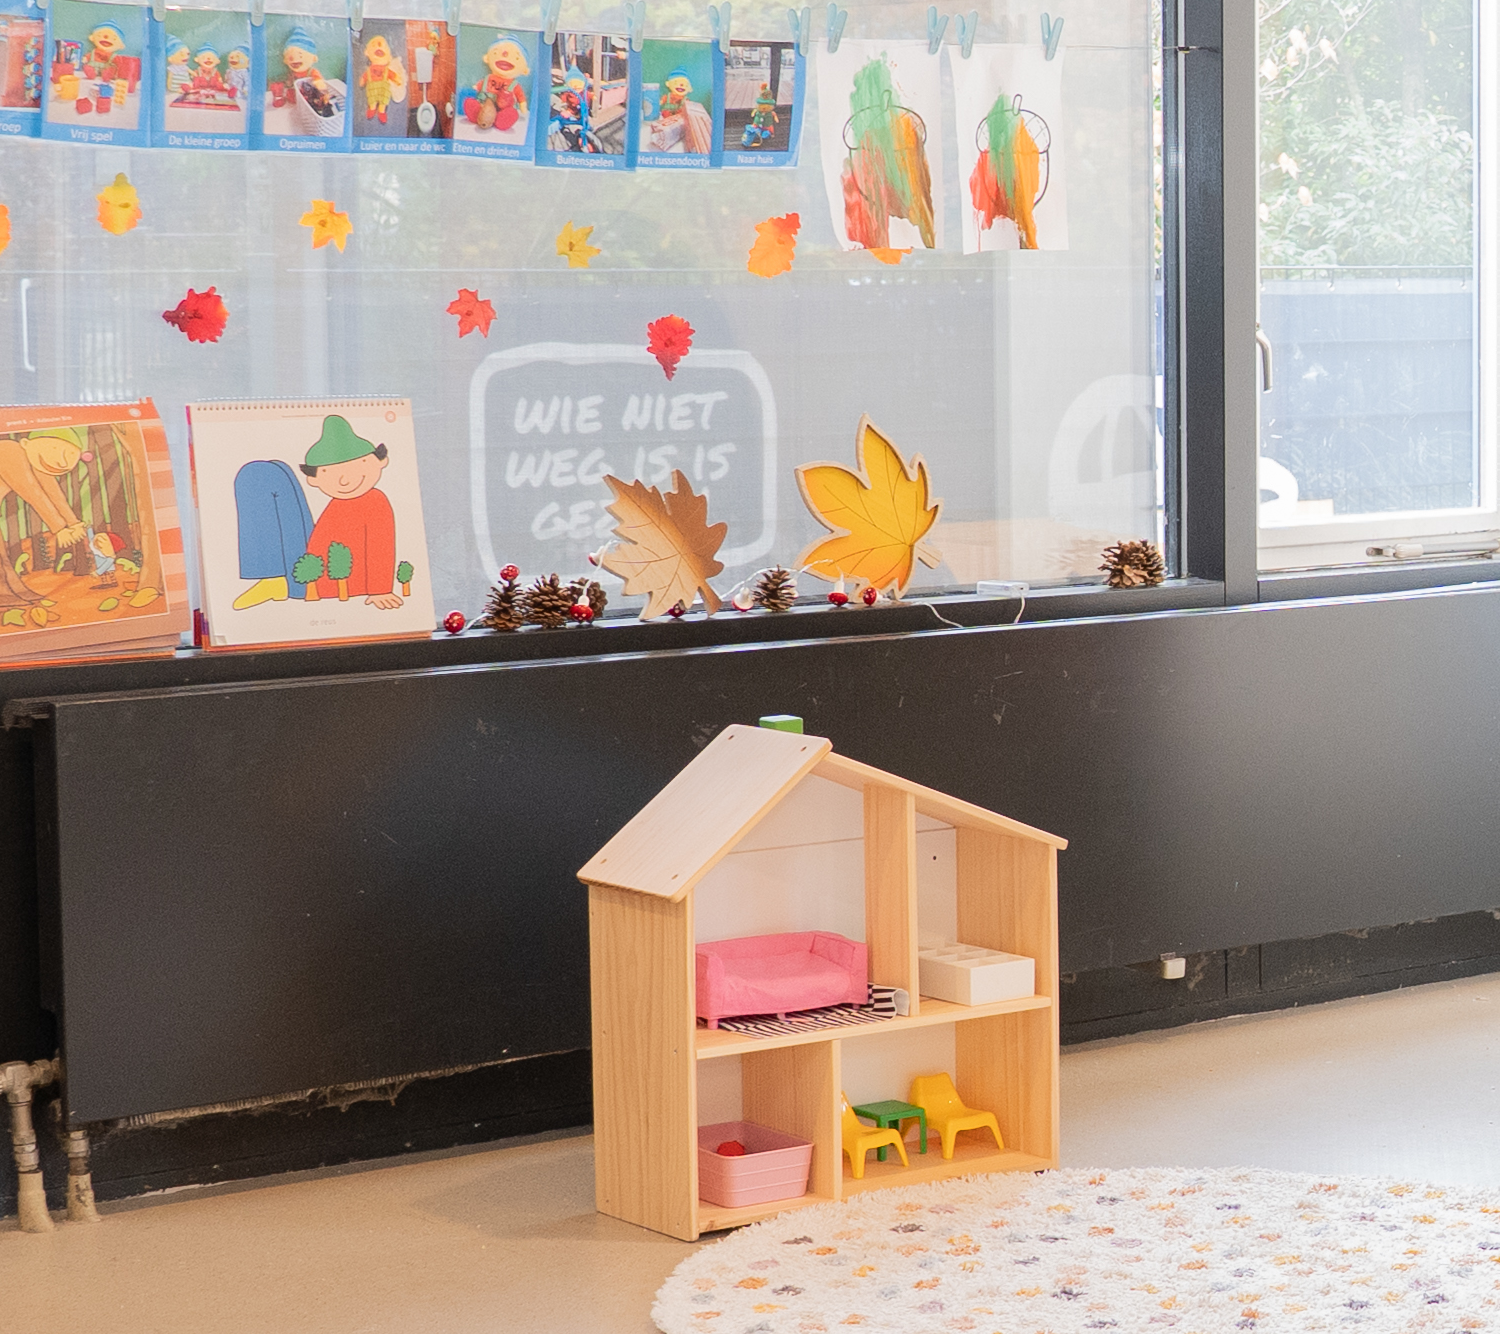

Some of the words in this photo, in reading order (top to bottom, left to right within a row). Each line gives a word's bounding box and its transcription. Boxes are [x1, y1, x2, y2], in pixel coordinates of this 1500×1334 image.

[71, 128, 89, 142] Vrij
[91, 131, 113, 143] spel
[168, 135, 182, 146] De
[184, 135, 213, 147] kleine
[213, 138, 242, 149] groep
[279, 138, 327, 151] Opruimen
[360, 141, 383, 152] Luier
[384, 142, 397, 152] en
[398, 142, 419, 152] naar
[420, 141, 432, 152] de
[433, 143, 446, 152] wc
[452, 142, 473, 154] Eten
[474, 145, 486, 155] en
[487, 144, 520, 158] drinken
[556, 153, 615, 169] Buitenspelen
[637, 155, 653, 166] Het
[737, 154, 757, 164] Naar
[757, 153, 774, 164] huis
[513, 394, 605, 435] WIE
[621, 390, 729, 432] NIET
[504, 447, 616, 489] WEG
[633, 443, 679, 484] IS
[692, 442, 738, 482] IS
